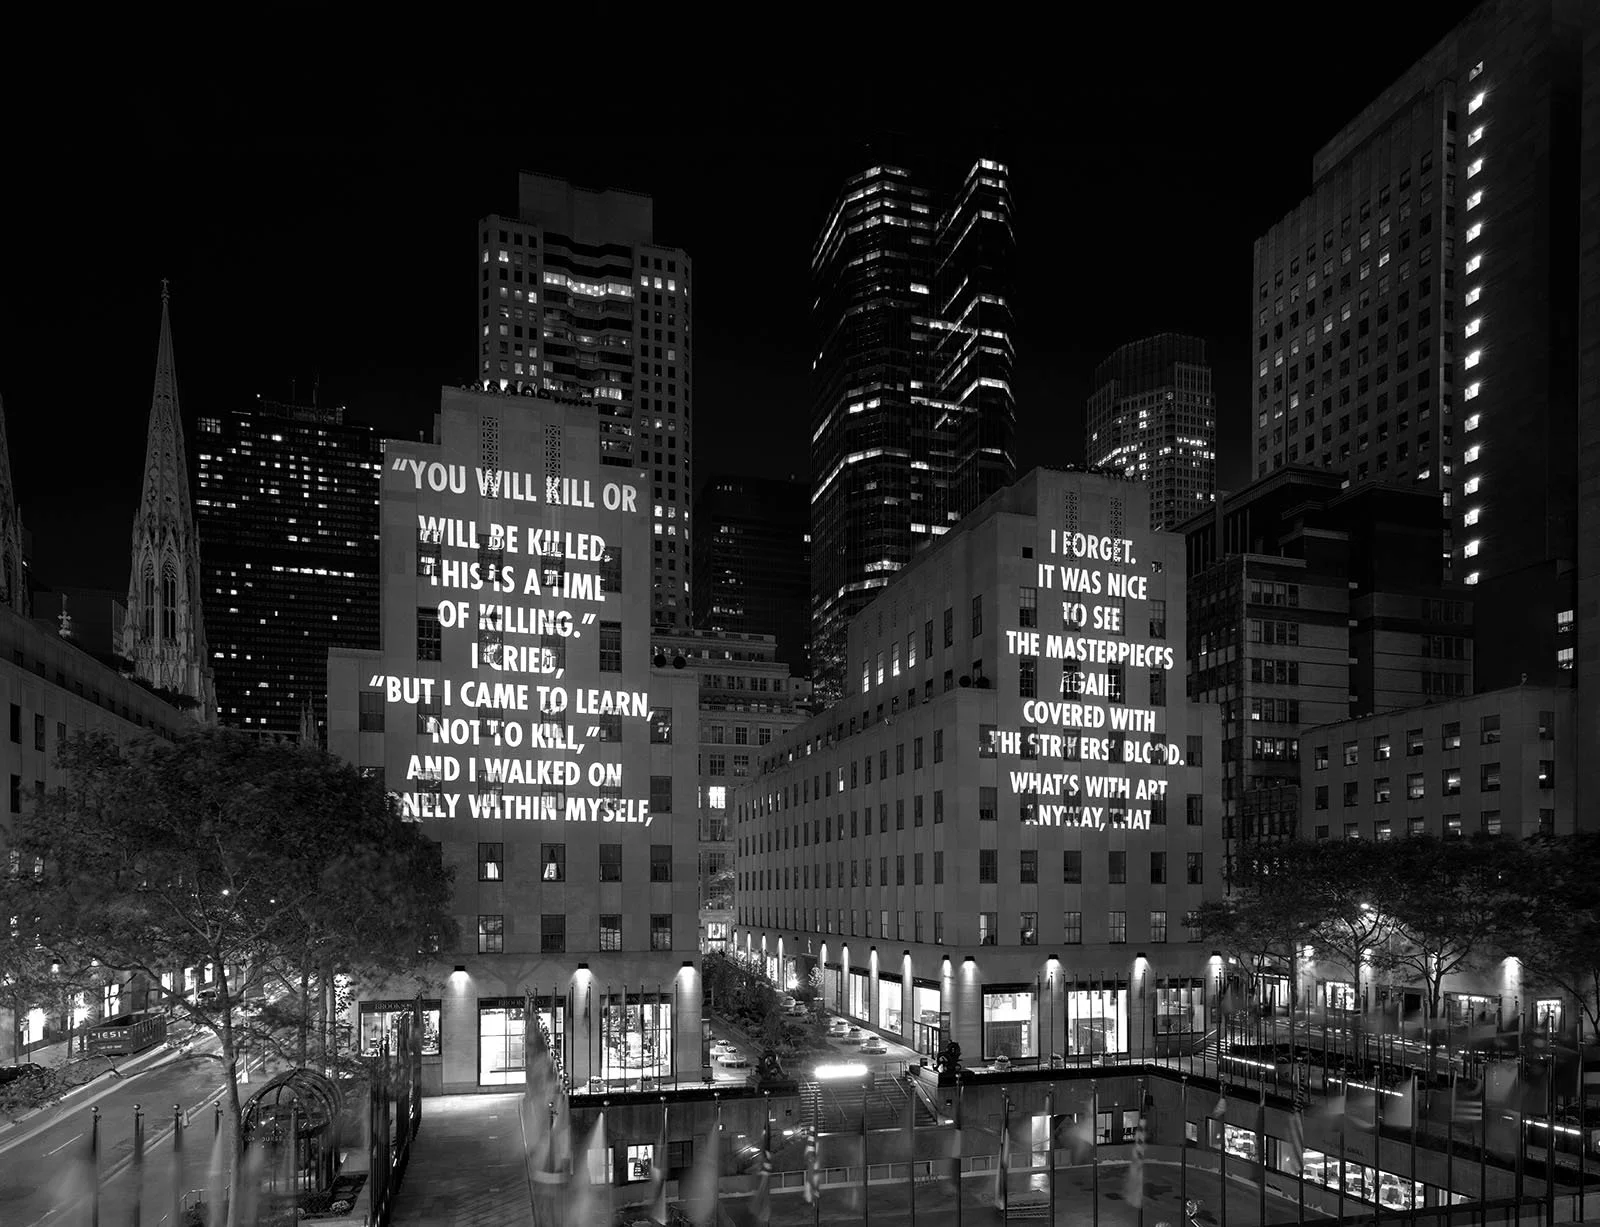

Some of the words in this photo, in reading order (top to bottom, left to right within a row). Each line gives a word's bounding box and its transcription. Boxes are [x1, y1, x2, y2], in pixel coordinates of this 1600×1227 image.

[475, 467, 537, 501] WILL
[546, 475, 595, 508] KILL
[602, 483, 637, 512] OR
[418, 515, 480, 549] WILL
[488, 523, 519, 553] BE
[1051, 529, 1056, 553] I
[1062, 531, 1136, 564] FORGET.
[421, 556, 484, 590] THIS
[488, 563, 515, 593] IS
[523, 568, 541, 596] A
[544, 569, 606, 602] TIME
[1038, 563, 1055, 589] IT
[1060, 566, 1101, 595] WAS
[1107, 572, 1148, 600] NICE
[438, 600, 470, 629] OF
[1062, 602, 1087, 627] TO
[1093, 605, 1120, 631] SEE
[472, 642, 478, 669] I
[484, 643, 565, 680] CRIED,
[1006, 630, 1040, 657] THE
[1046, 635, 1174, 670] MASTERPIECES
[369, 675, 435, 705] "BUT
[444, 680, 450, 706] I
[460, 681, 528, 711] CAME
[537, 686, 568, 715] TO
[576, 688, 654, 722] LEARN,
[1023, 700, 1105, 728] COVERED
[1110, 707, 1156, 733] WITH
[430, 717, 480, 745] NOT
[487, 720, 523, 747] TO
[531, 722, 600, 754] KILL,"
[989, 730, 1021, 755] THE
[406, 755, 460, 782] AND
[469, 757, 476, 783] I
[484, 757, 580, 786] WALKED
[588, 762, 622, 787] ON
[1010, 771, 1080, 796] WHAT'S
[1085, 775, 1130, 799] WITH
[1135, 778, 1168, 801] ART
[468, 794, 557, 820] WITHIN
[565, 797, 653, 827] MYSELF,
[1109, 808, 1151, 830] THAT
